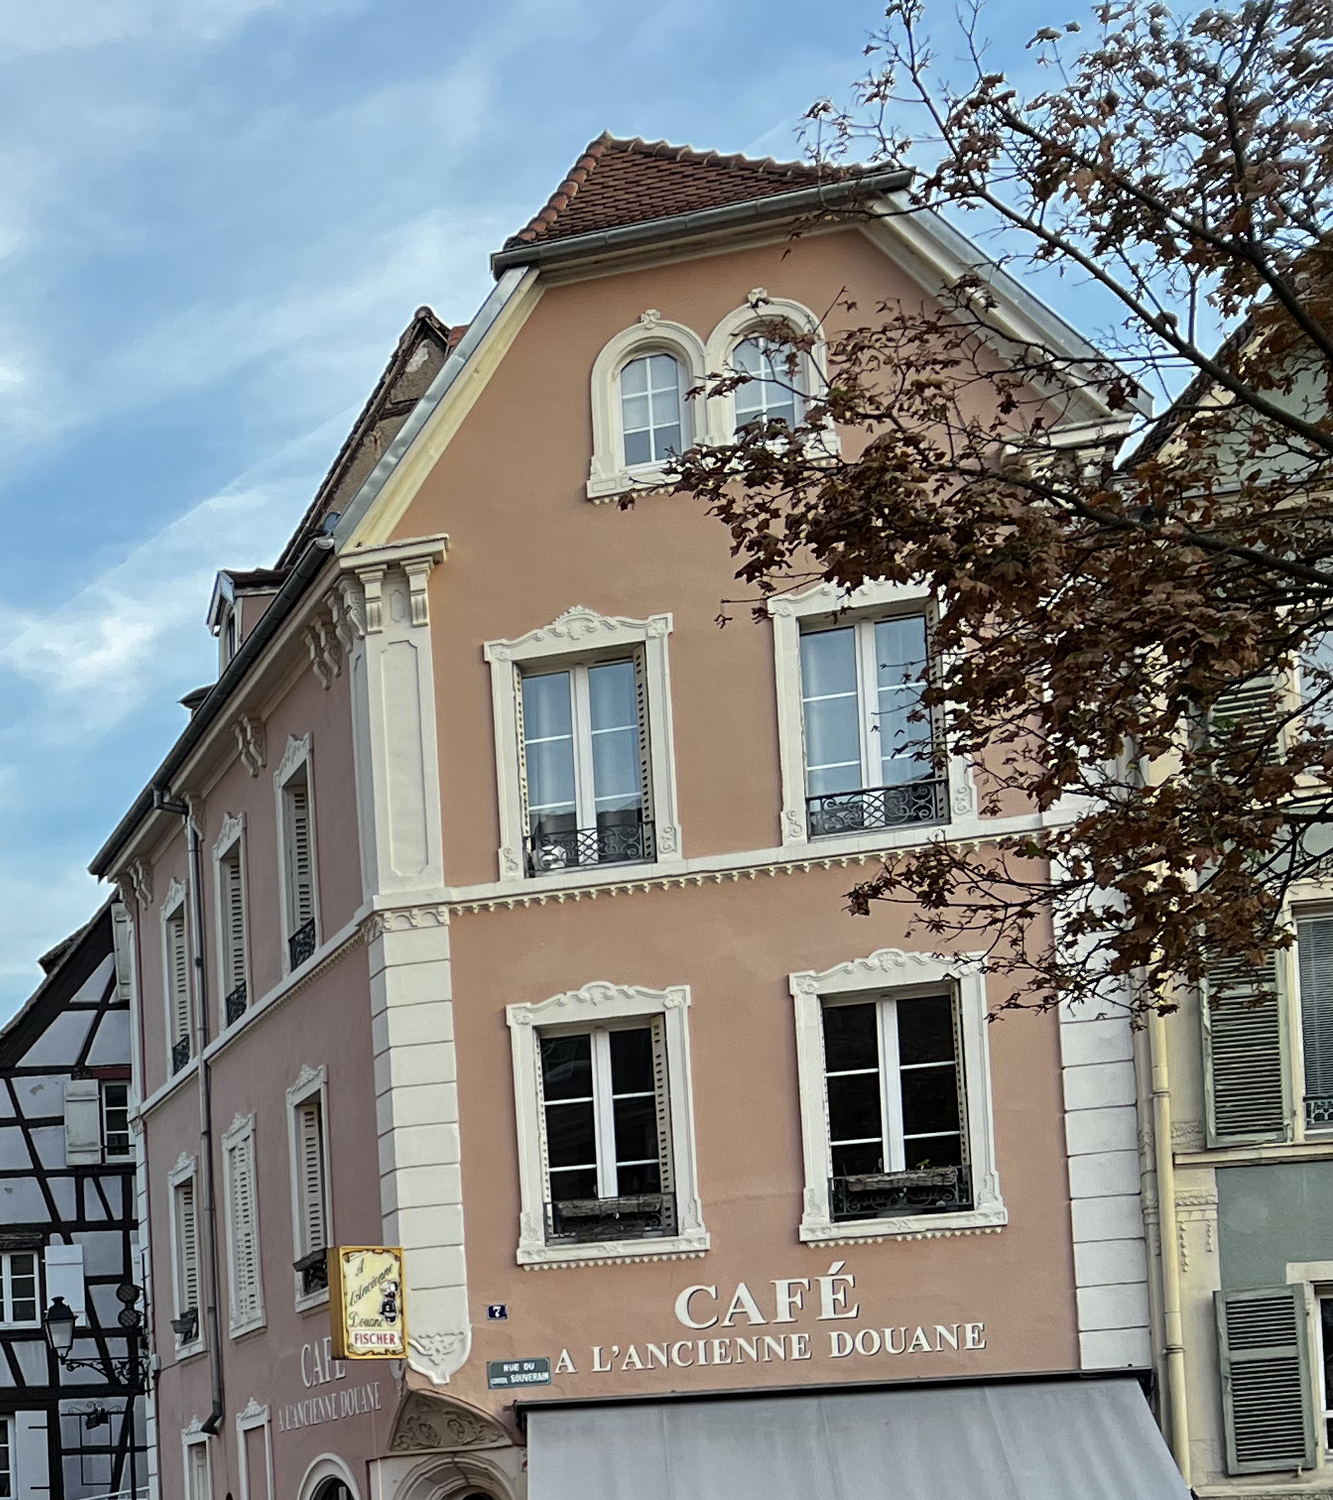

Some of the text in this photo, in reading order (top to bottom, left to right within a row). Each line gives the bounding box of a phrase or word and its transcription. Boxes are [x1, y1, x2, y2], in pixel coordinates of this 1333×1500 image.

[674, 1261, 860, 1330] CAFÉ
[492, 1305, 502, 1318] 7
[354, 1332, 397, 1346] FISCHER
[554, 1322, 988, 1375] A L'ANCIENNE DOUANE
[503, 1362, 535, 1372] RUE DU
[510, 1371, 550, 1384] SOUVERAIN
[278, 1382, 383, 1432] A L'ANCIENNE DOUANE
